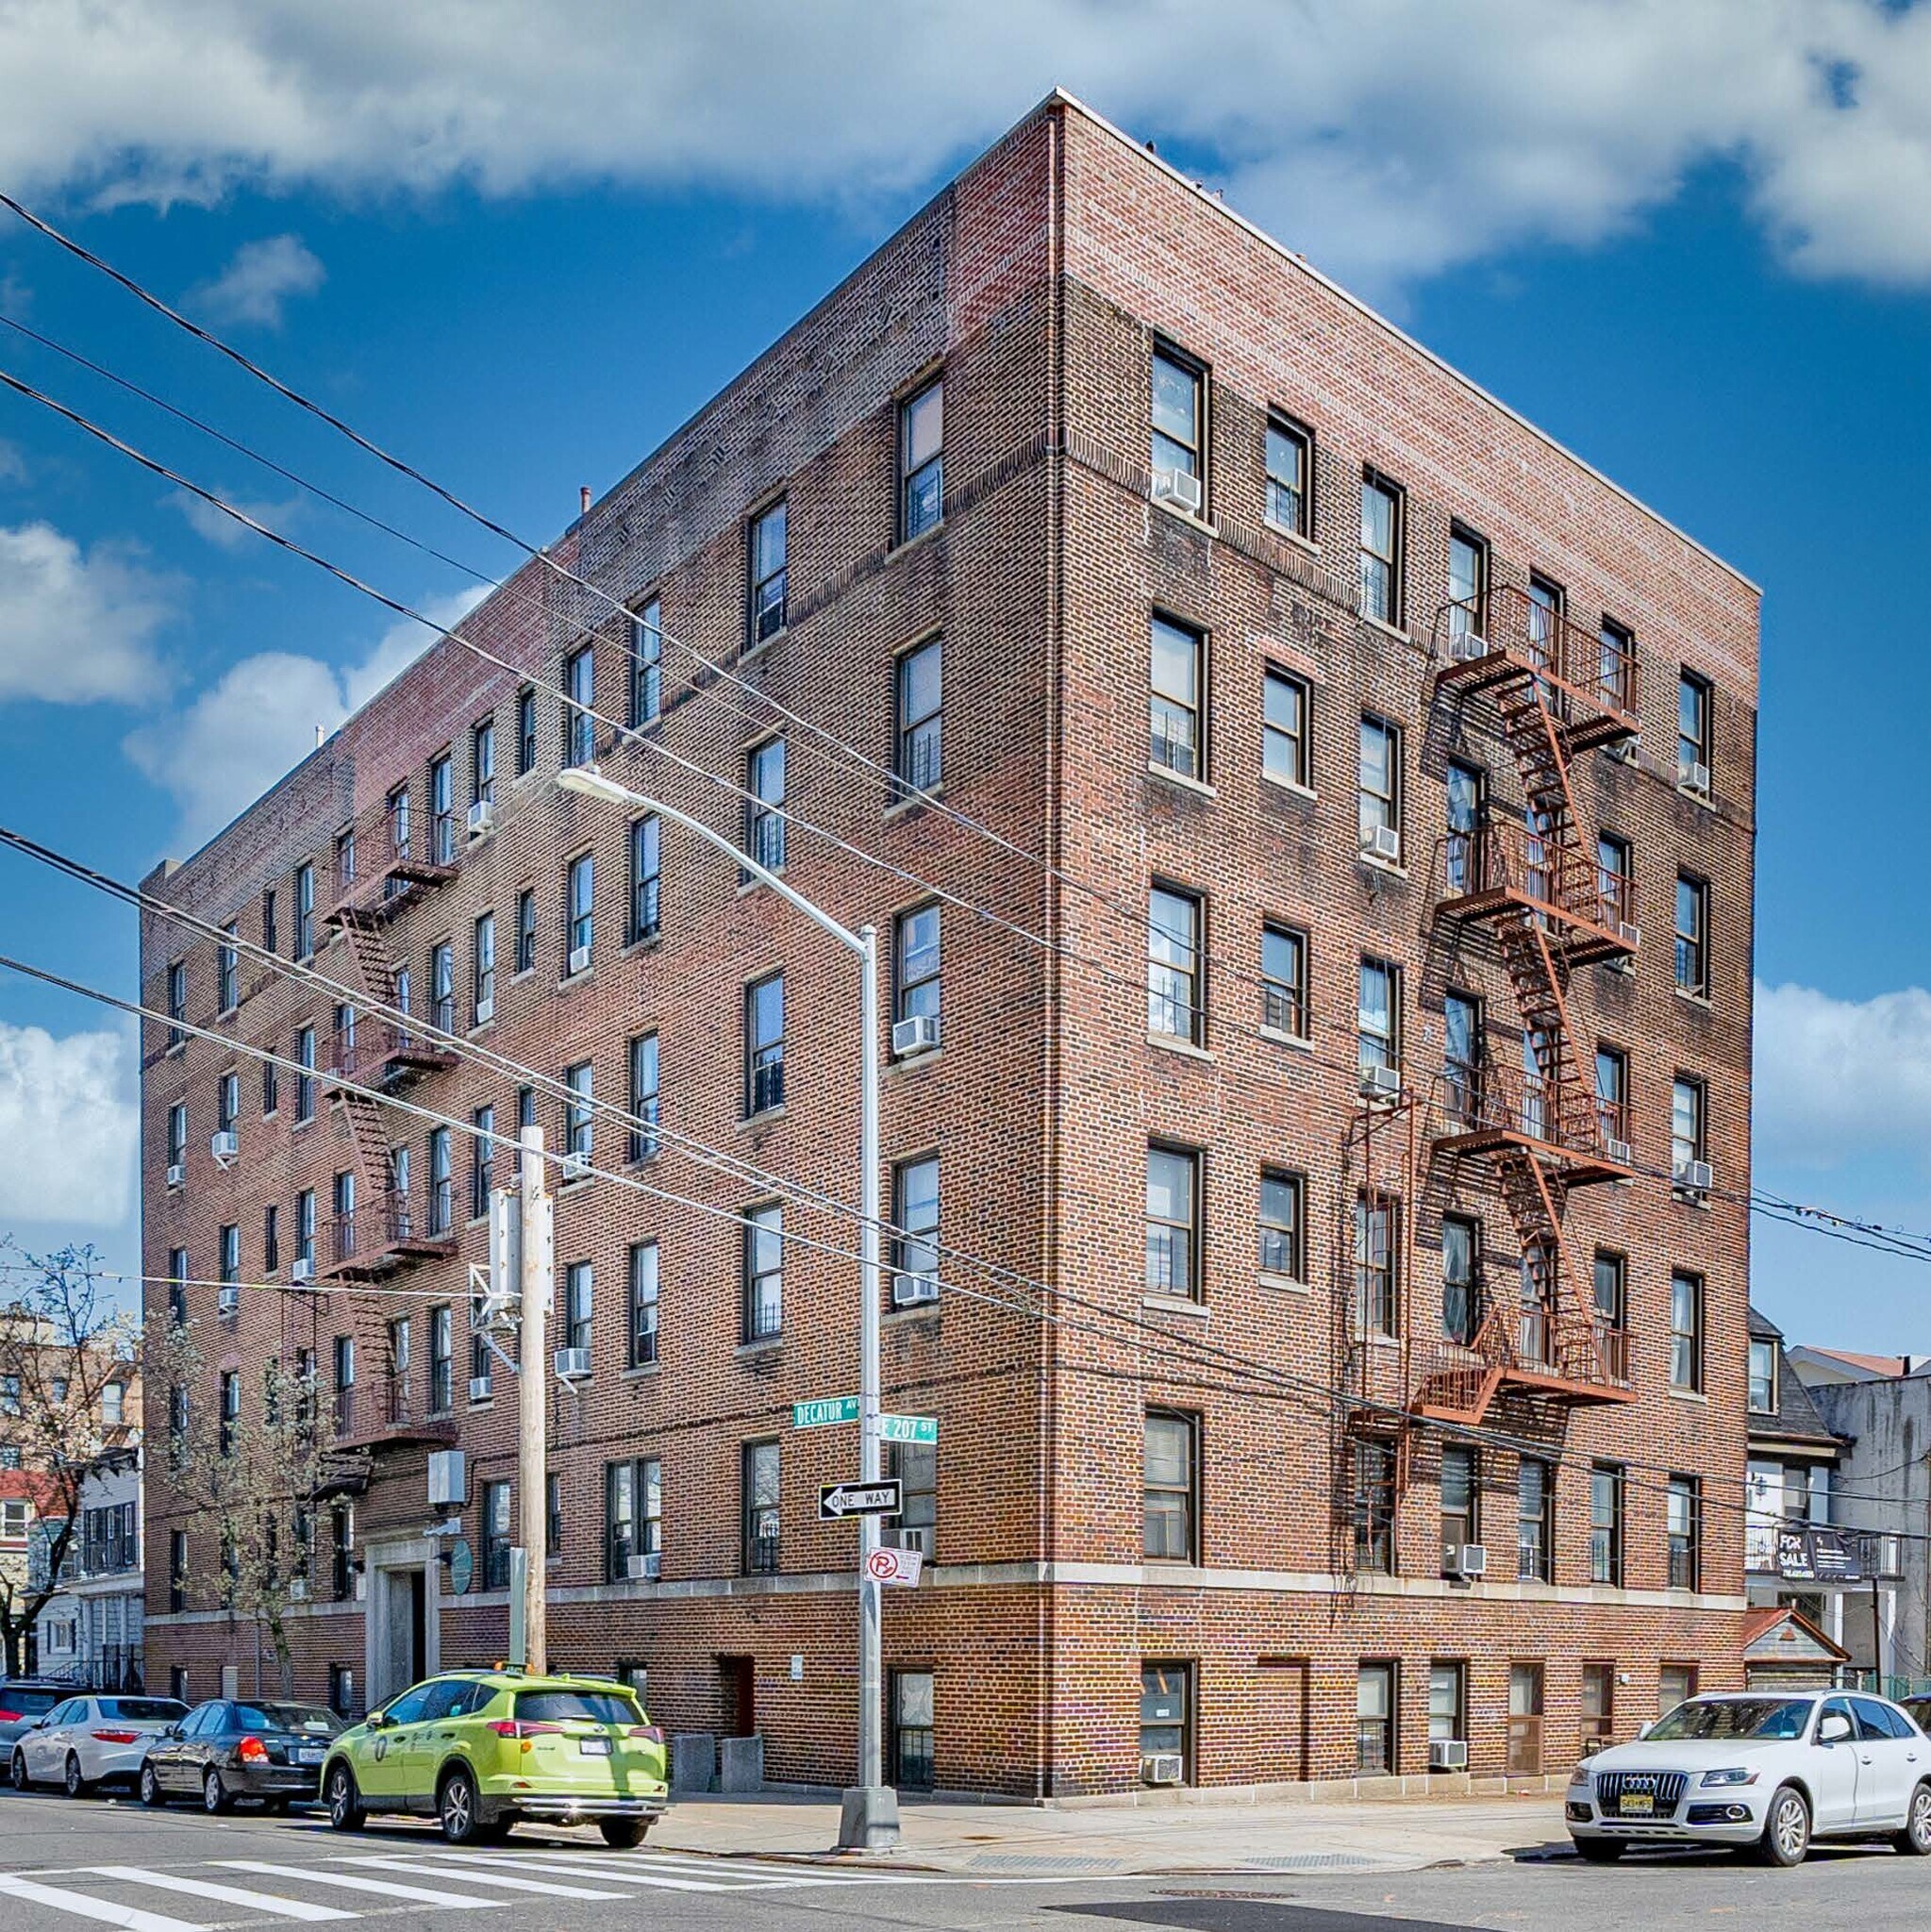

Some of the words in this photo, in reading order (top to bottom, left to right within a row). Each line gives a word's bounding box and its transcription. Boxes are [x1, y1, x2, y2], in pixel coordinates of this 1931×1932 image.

[797, 1402, 842, 1424] DECATUR
[846, 1400, 857, 1409] AV
[882, 1417, 891, 1438] E
[893, 1419, 917, 1439] 207
[921, 1422, 932, 1432] ST
[832, 1494, 855, 1507] ONE
[865, 1491, 890, 1505] WAY
[1779, 1534, 1802, 1549] FOR
[1779, 1552, 1808, 1567] SALE
